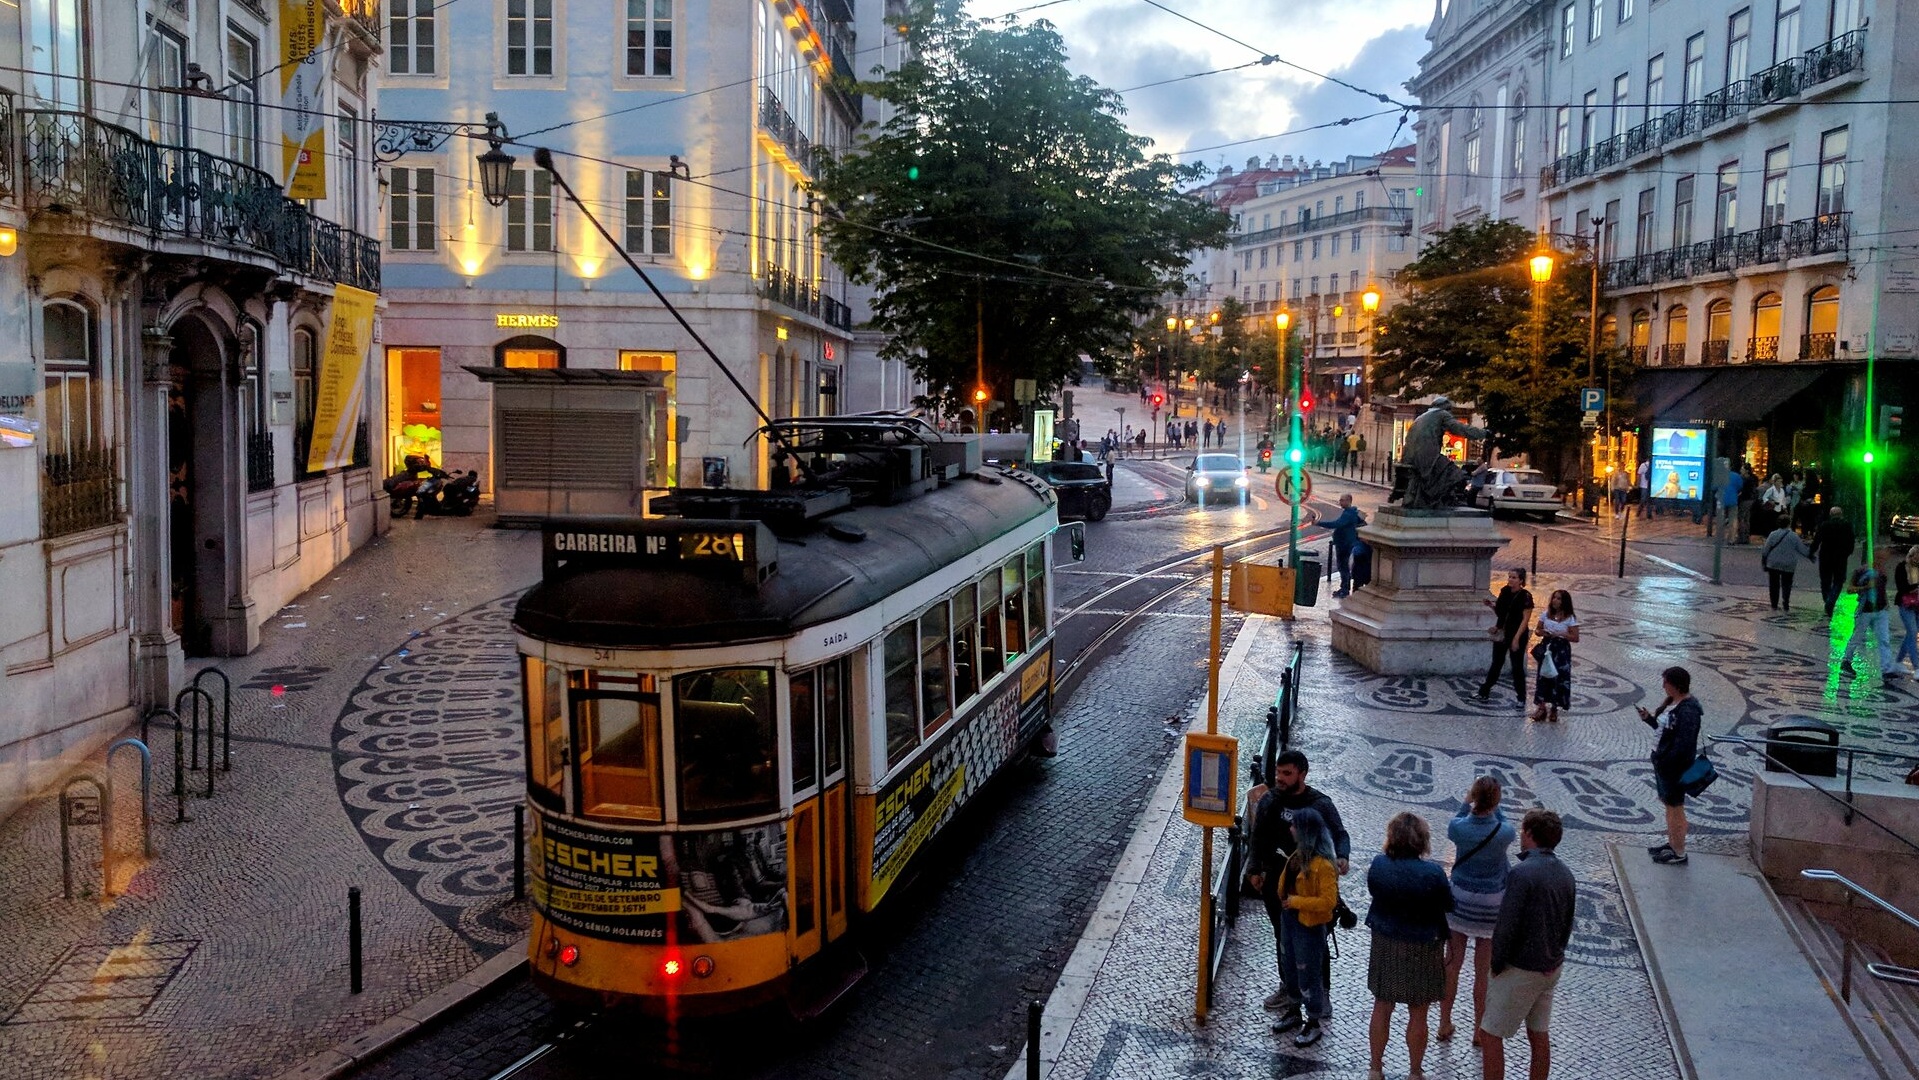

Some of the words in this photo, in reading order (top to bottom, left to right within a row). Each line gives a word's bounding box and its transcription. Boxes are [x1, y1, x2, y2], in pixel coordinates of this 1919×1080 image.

[288, 31, 297, 64] Years
[496, 313, 559, 328] HERMÈS
[1585, 390, 1601, 409] P
[554, 532, 637, 554] CARREIRA
[646, 535, 667, 555] Nº
[594, 649, 616, 662] 541
[875, 760, 931, 832] ESCHER
[544, 837, 658, 878] ESCHER
[588, 875, 622, 887] POPULAR
[629, 880, 661, 889] LISBOA
[571, 901, 622, 912] SEPTEMBER
[607, 893, 661, 903] SETEMBRO
